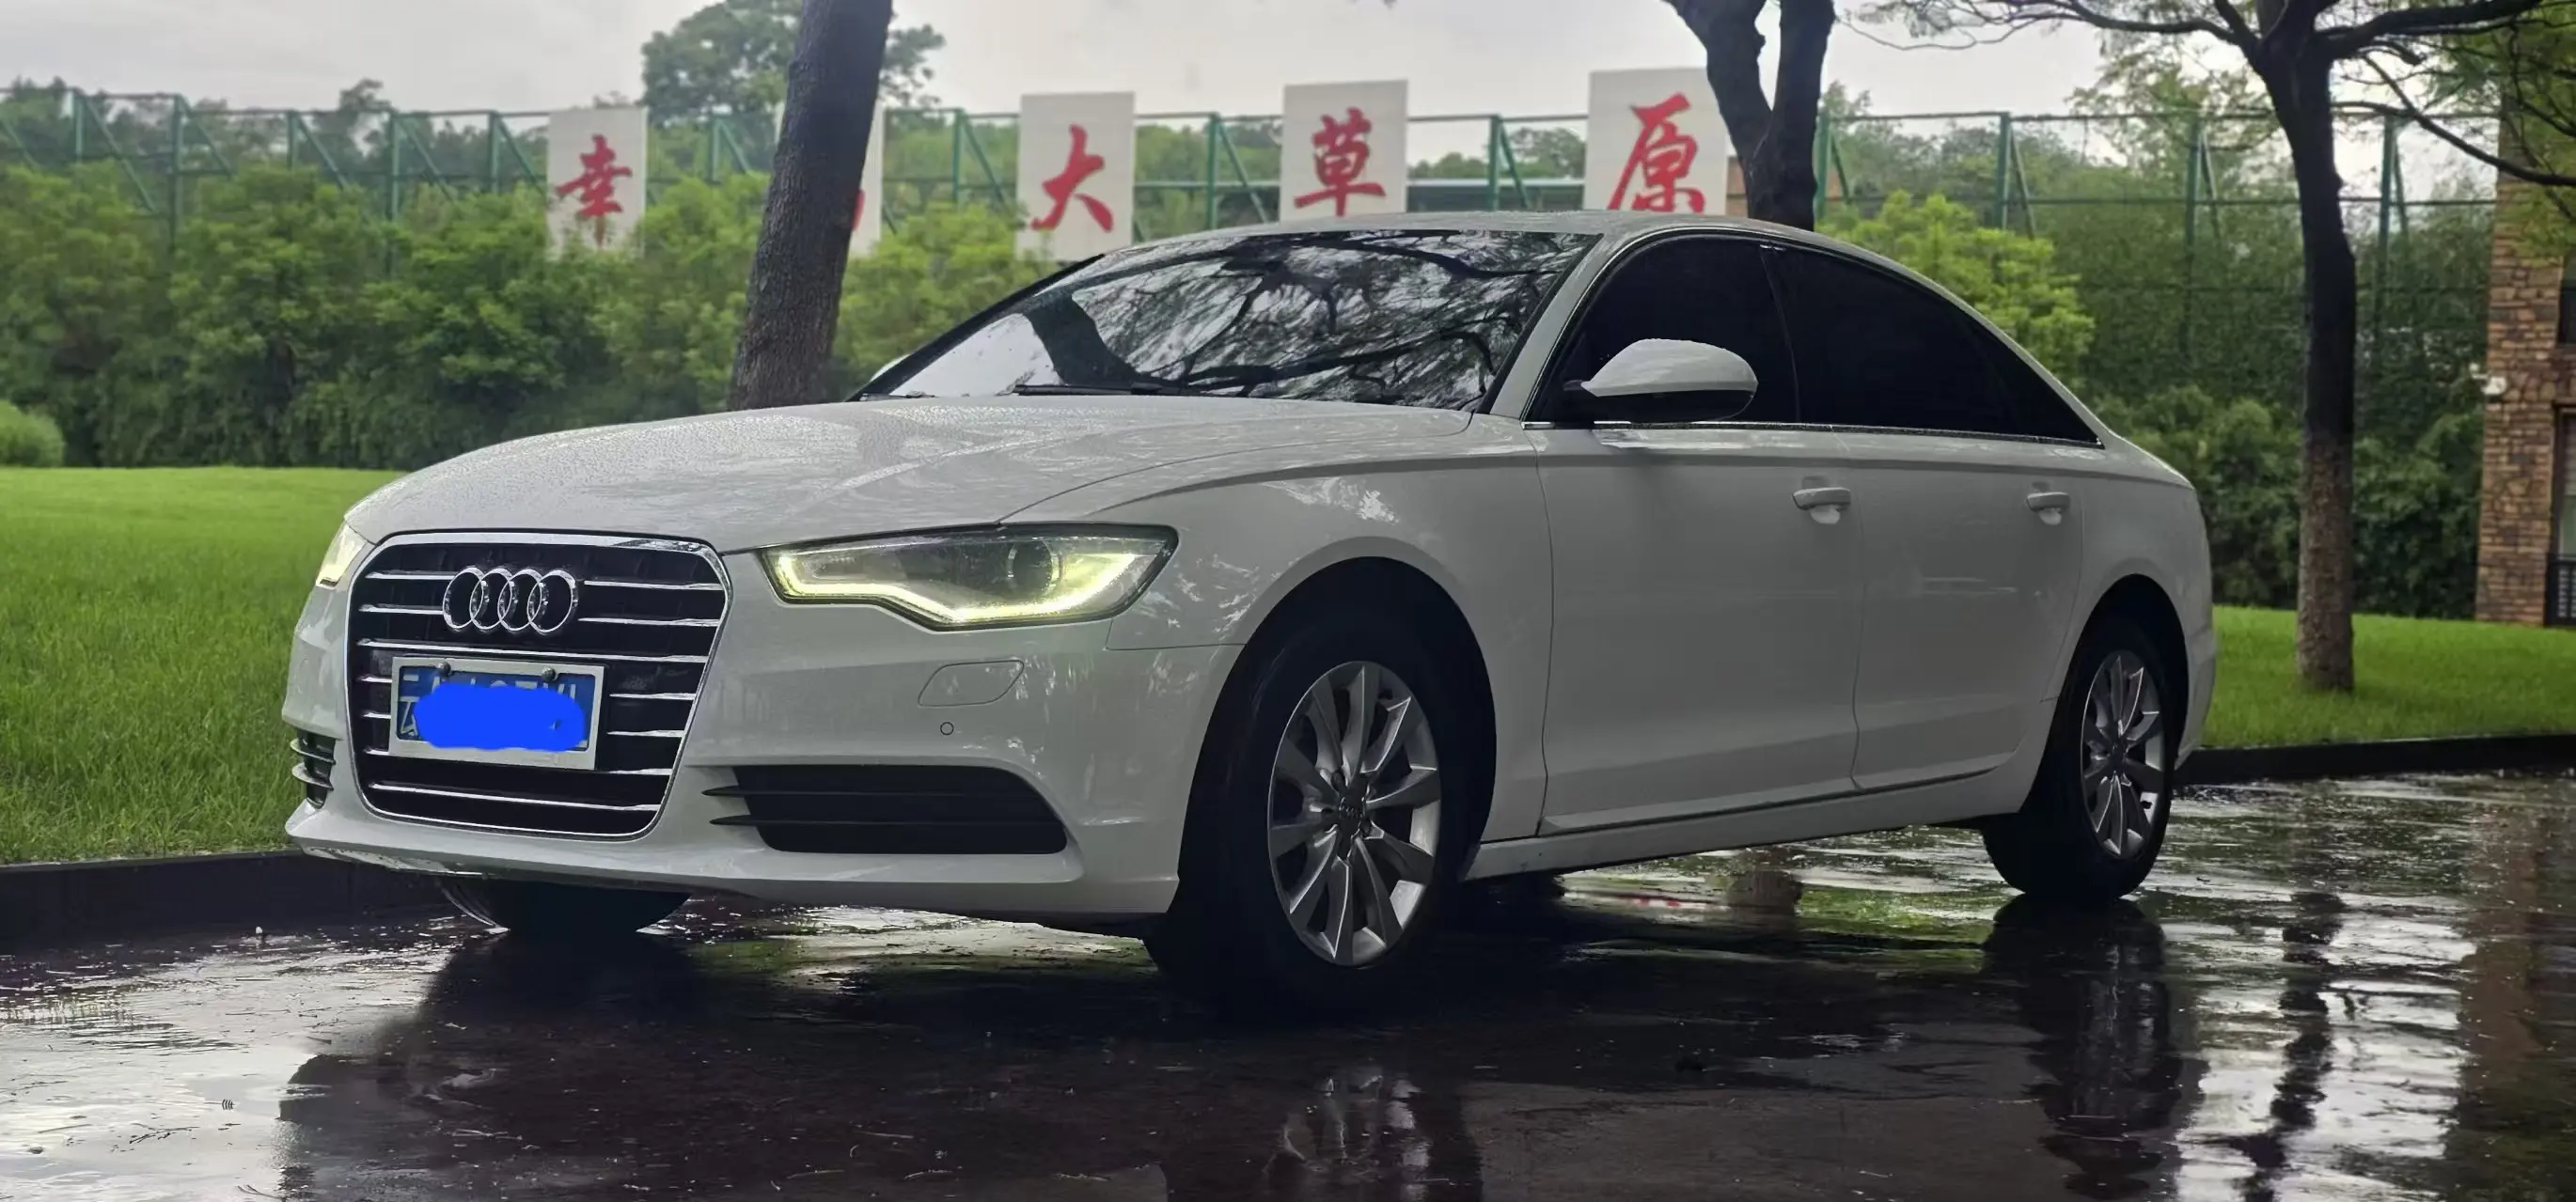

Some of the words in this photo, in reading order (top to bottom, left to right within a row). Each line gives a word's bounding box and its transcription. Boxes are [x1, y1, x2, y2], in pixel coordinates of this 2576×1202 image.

[557, 133, 633, 248] 幸
[1029, 123, 1114, 232] 大
[1294, 106, 1387, 217] 草
[1607, 91, 1705, 214] 原
